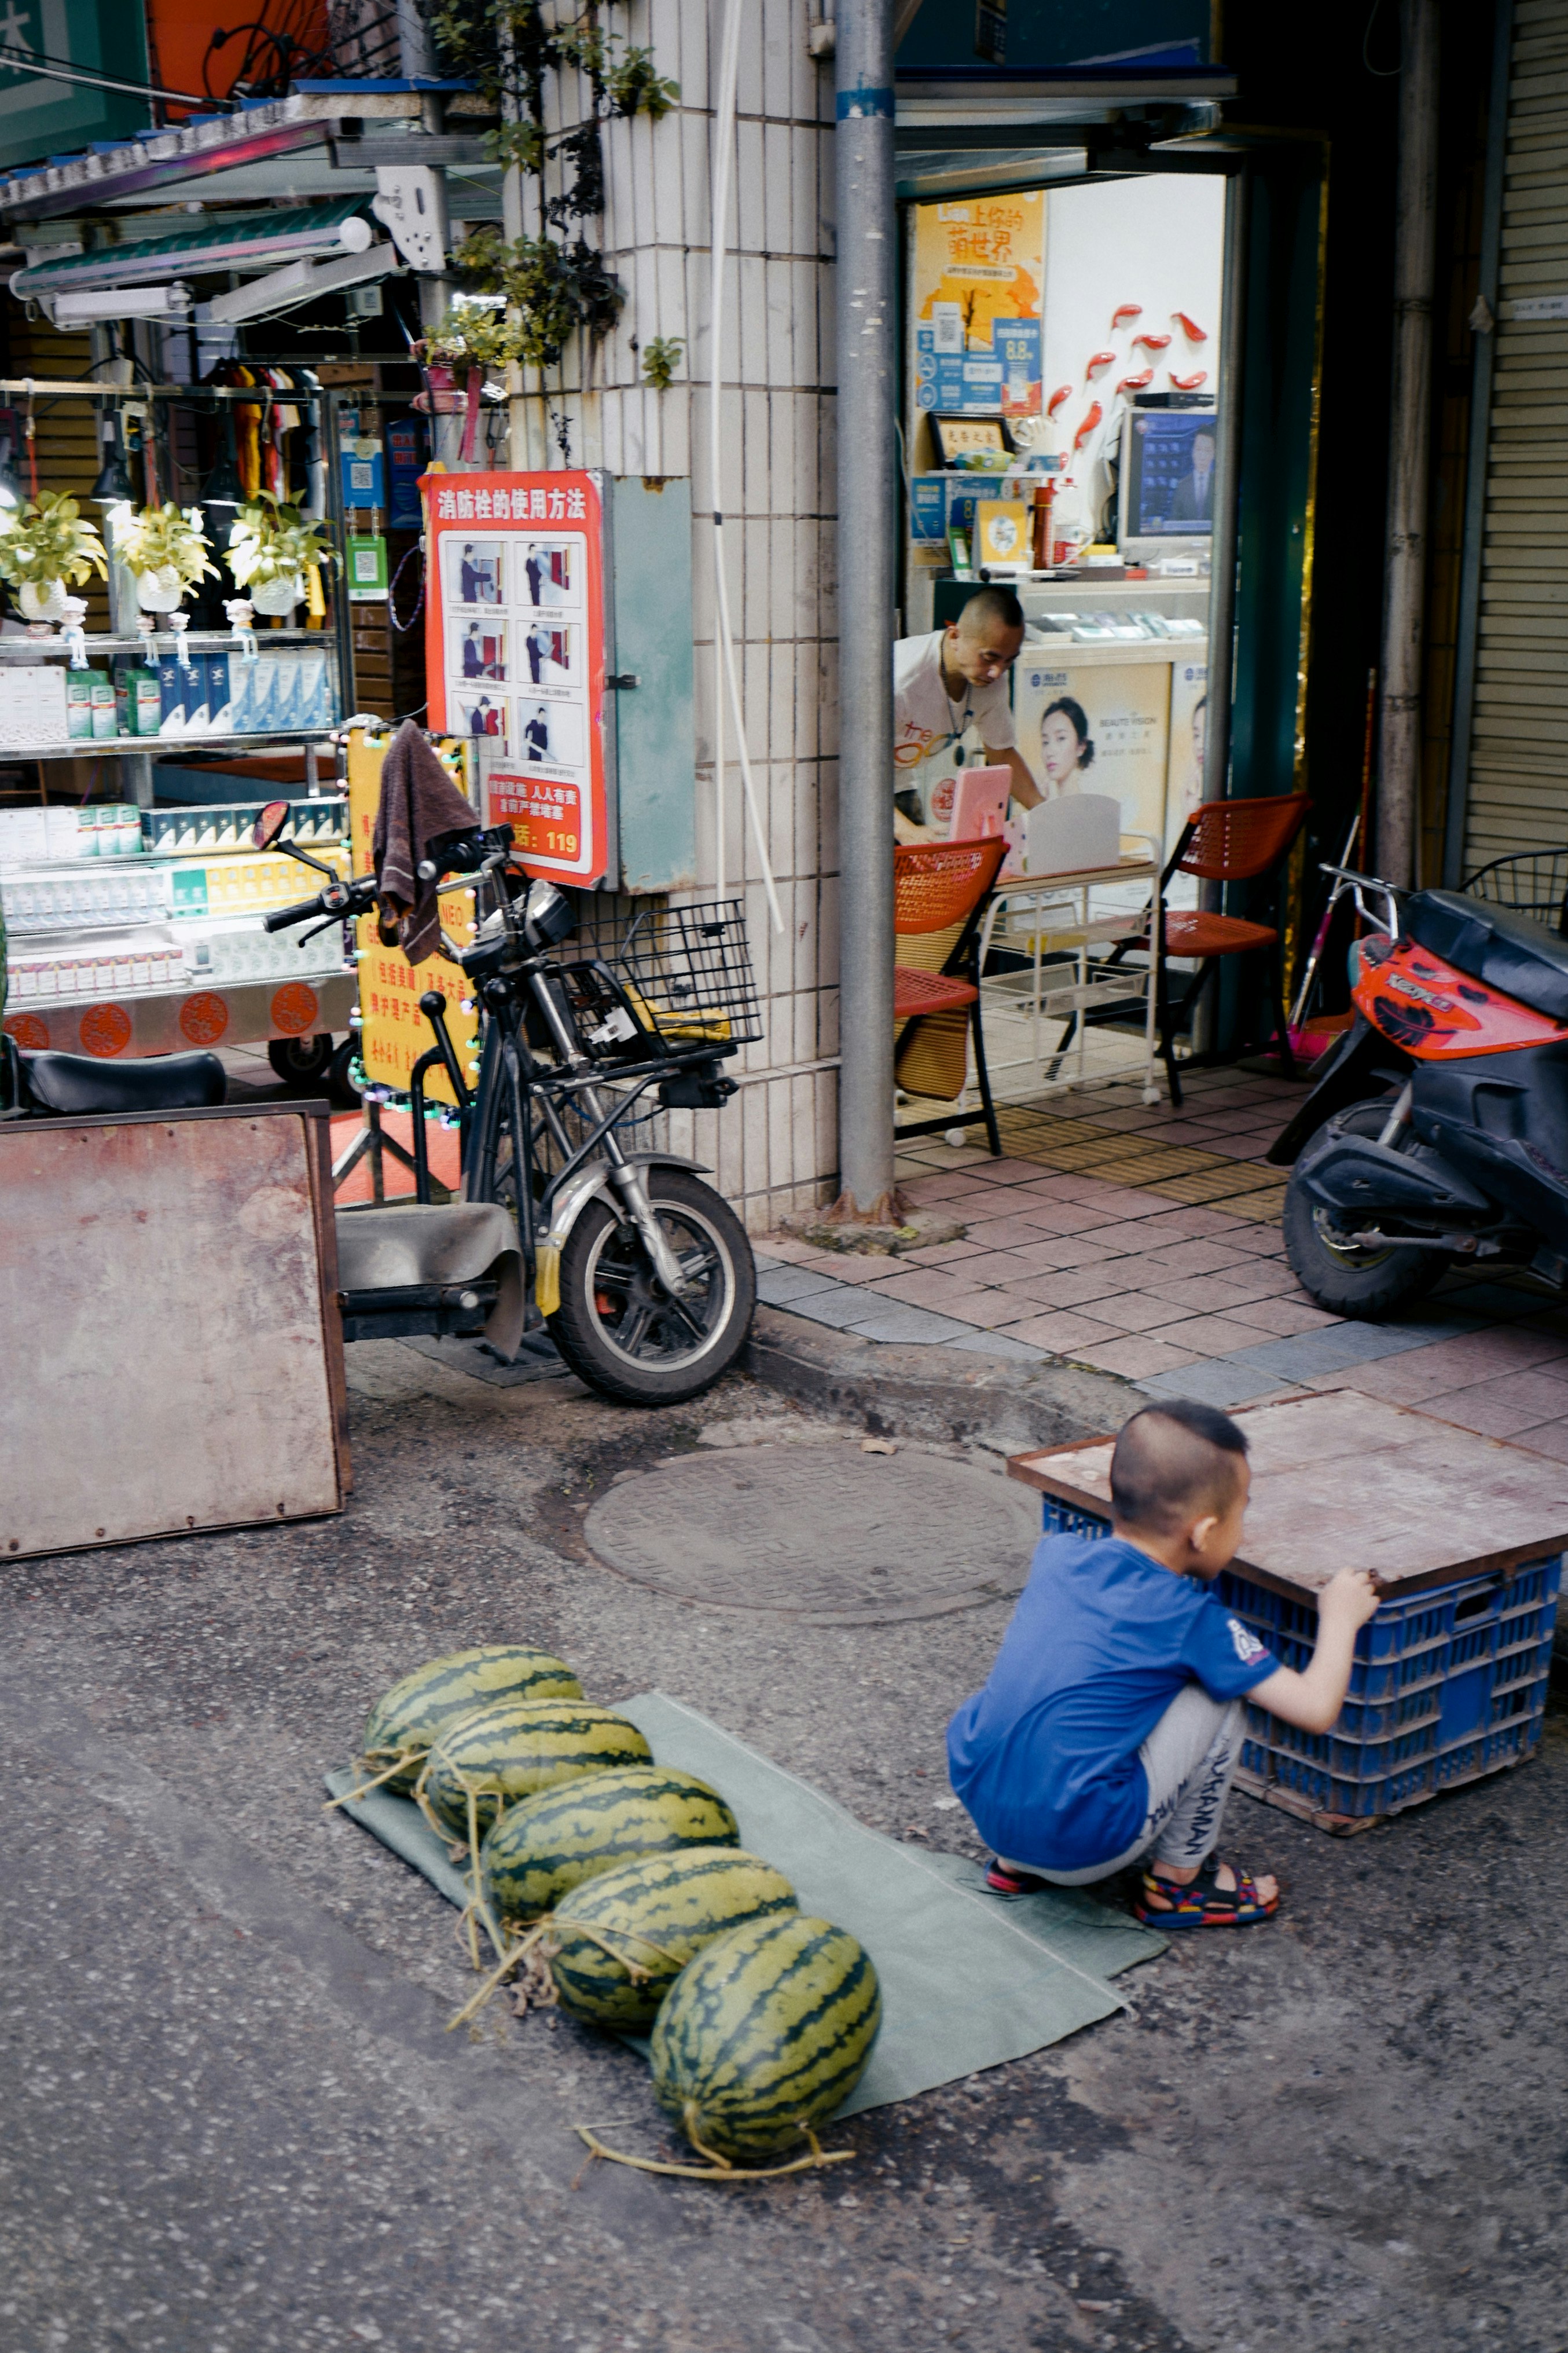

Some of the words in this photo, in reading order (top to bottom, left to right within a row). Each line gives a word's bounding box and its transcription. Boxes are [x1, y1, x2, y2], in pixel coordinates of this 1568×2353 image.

[948, 228, 1012, 262] 萌世界
[438, 488, 586, 519] 消防栓的使用方法
[531, 786, 577, 805] 人人有责
[546, 831, 578, 853] 119
